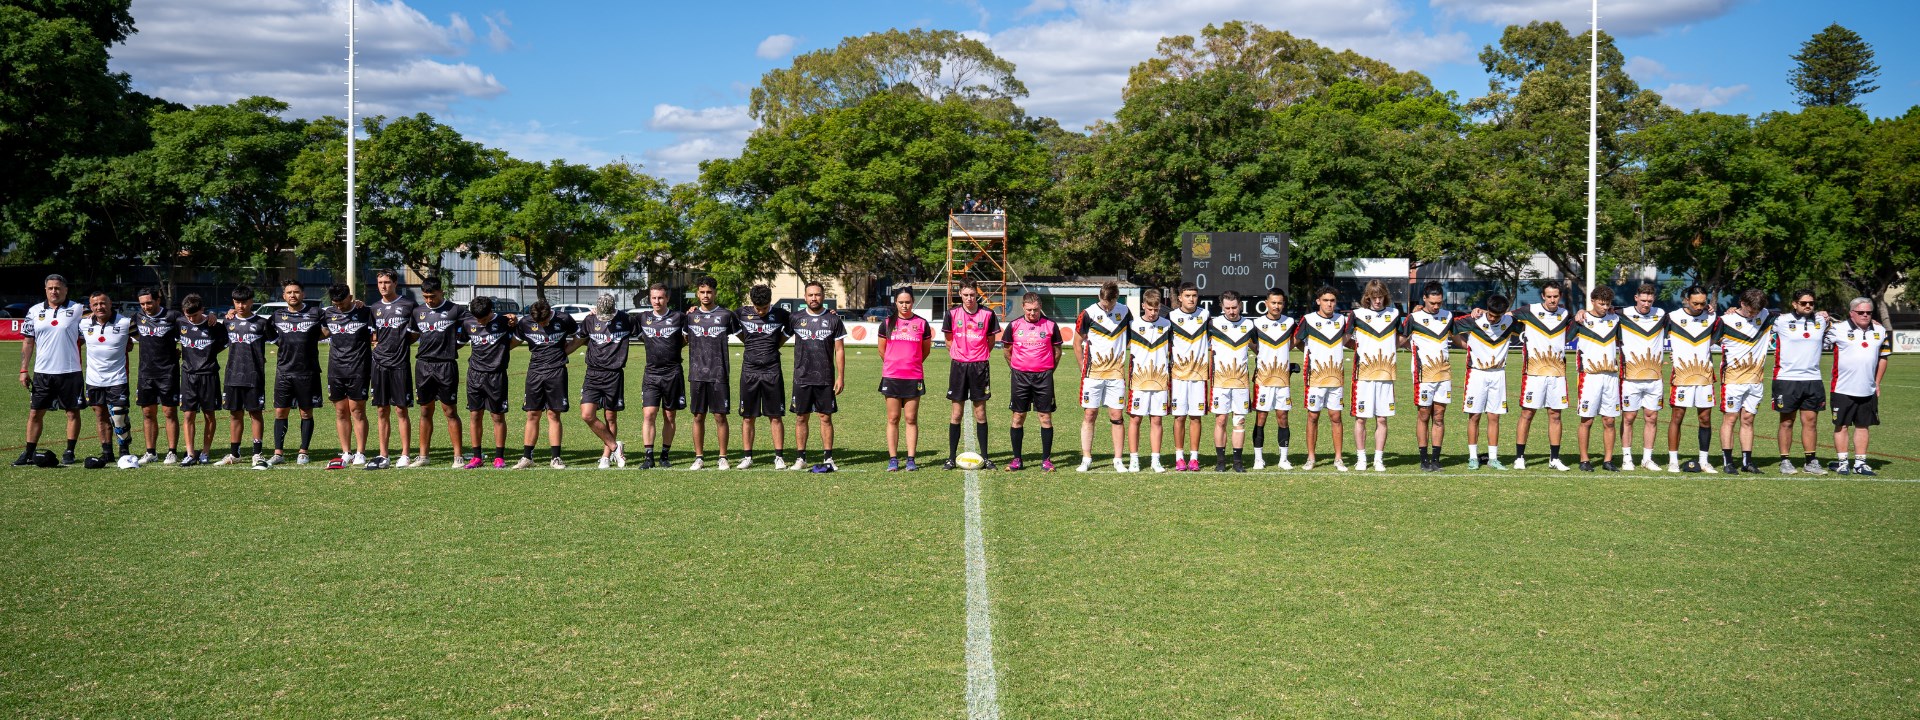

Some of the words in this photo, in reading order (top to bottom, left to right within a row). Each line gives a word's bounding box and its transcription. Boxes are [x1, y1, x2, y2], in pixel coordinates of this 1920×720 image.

[1229, 253, 1241, 261] H1
[1222, 265, 1250, 275] 00:00
[1196, 274, 1206, 290] 0
[1265, 274, 1275, 290] 0
